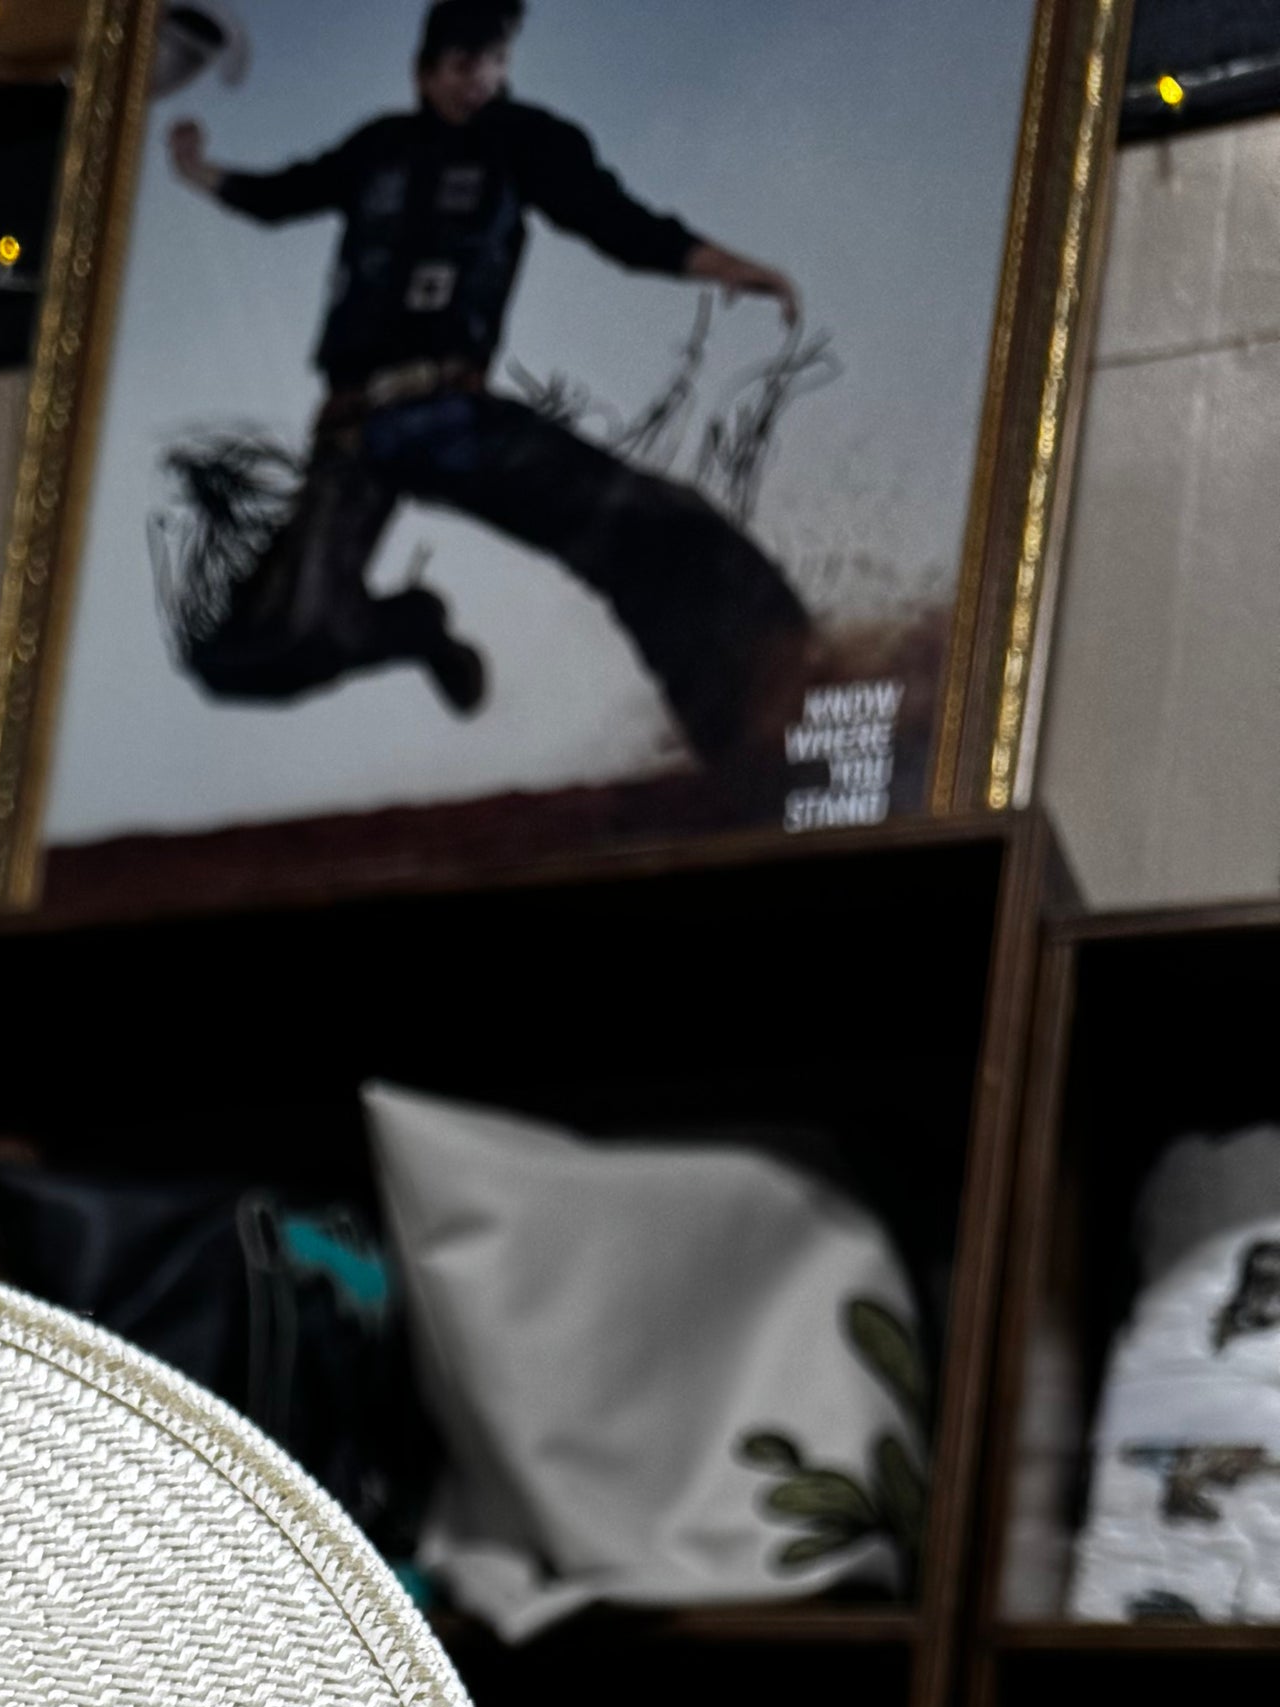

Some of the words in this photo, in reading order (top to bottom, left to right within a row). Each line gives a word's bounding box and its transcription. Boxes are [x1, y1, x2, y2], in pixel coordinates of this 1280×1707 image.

[802, 679, 905, 728] KNOW
[785, 722, 892, 765] WHERE
[829, 752, 894, 792] YOU
[783, 788, 890, 833] STAND
